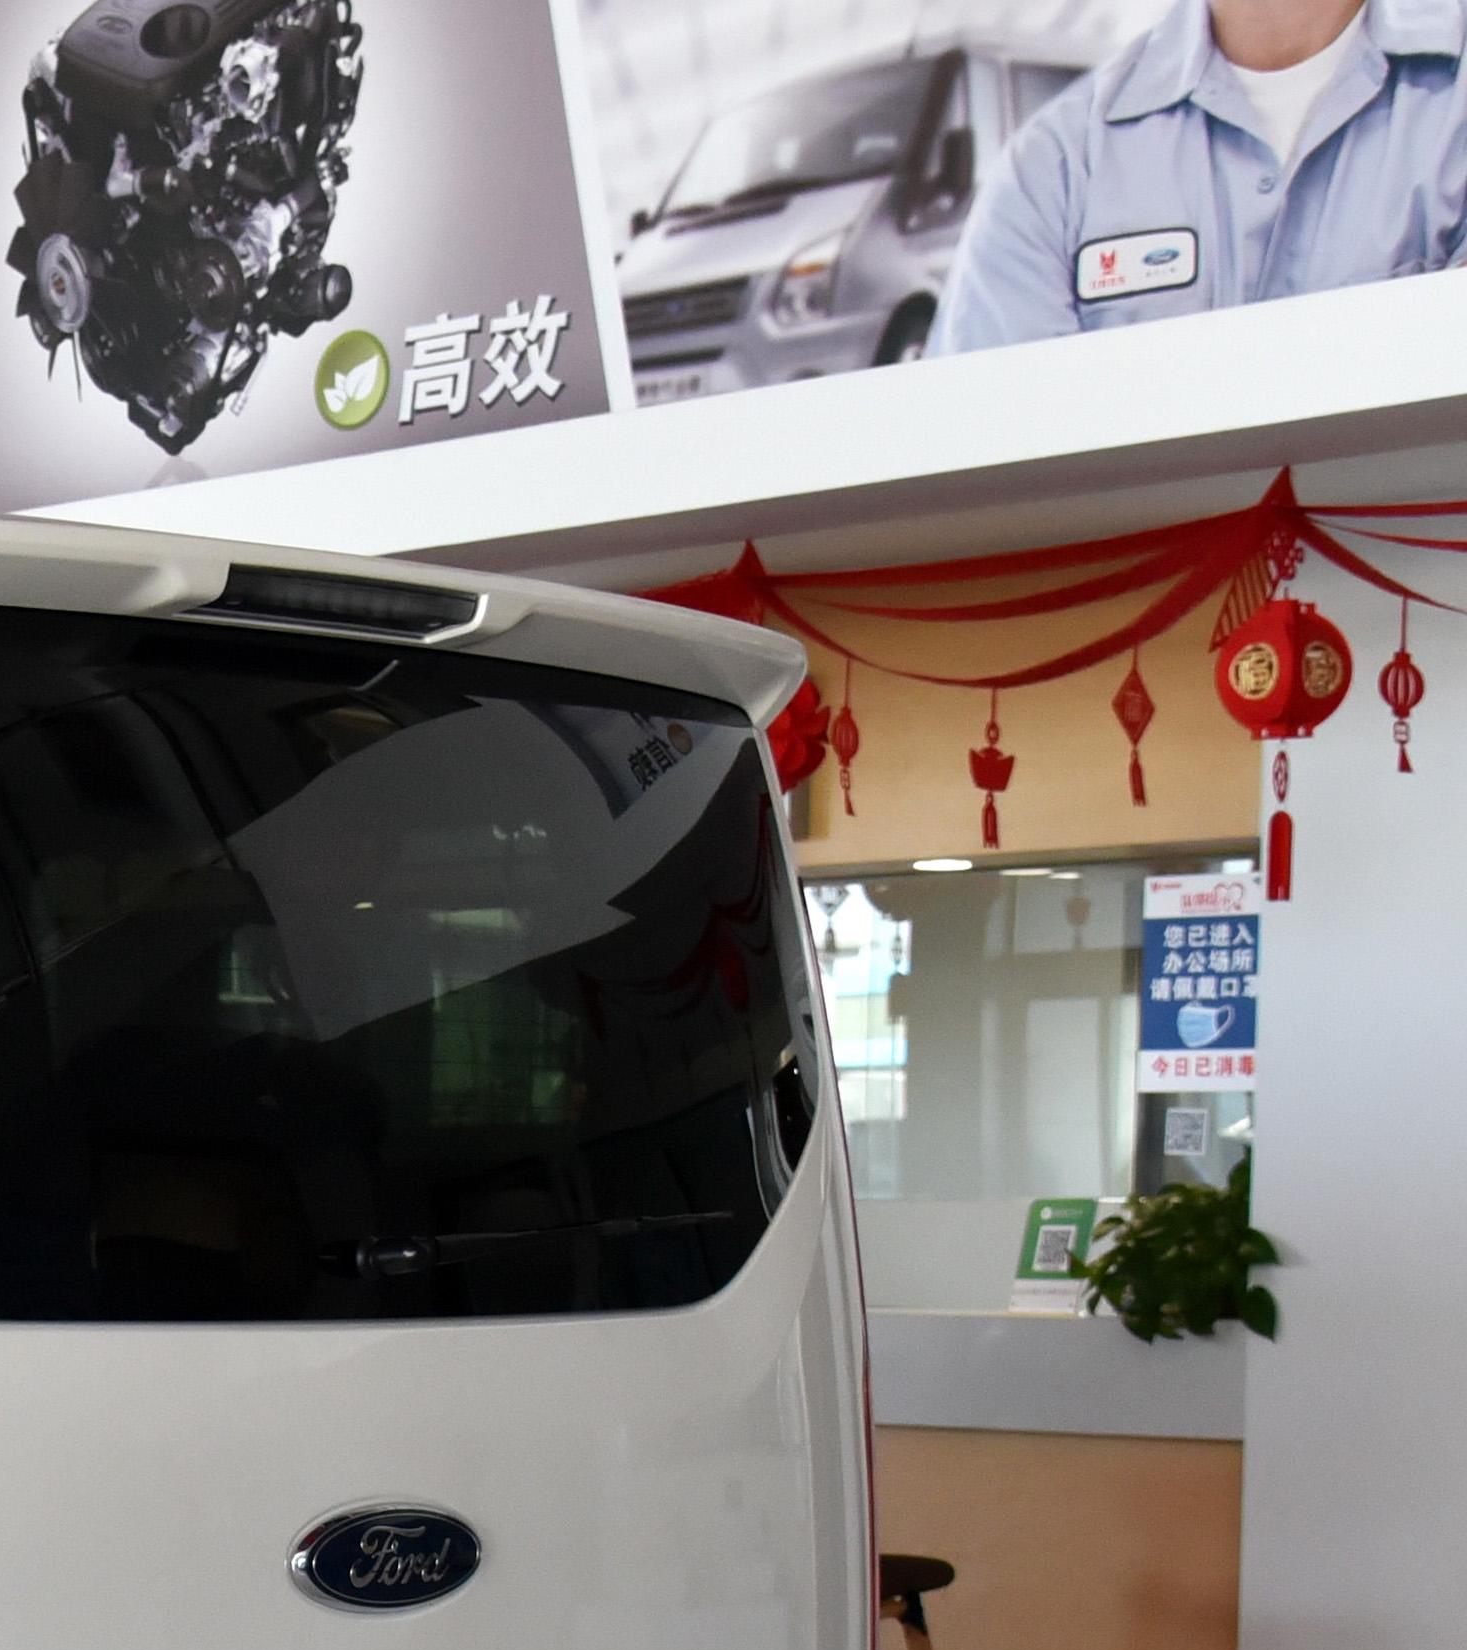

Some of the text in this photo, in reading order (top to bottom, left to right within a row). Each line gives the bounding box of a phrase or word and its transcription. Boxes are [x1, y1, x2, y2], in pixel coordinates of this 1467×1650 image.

[397, 294, 569, 426] 高效
[1162, 922, 1256, 949] 您已进入
[1161, 948, 1255, 974] 办公场所
[1151, 1055, 1255, 1078] 今日已消毒
[348, 1524, 452, 1589] Ford
